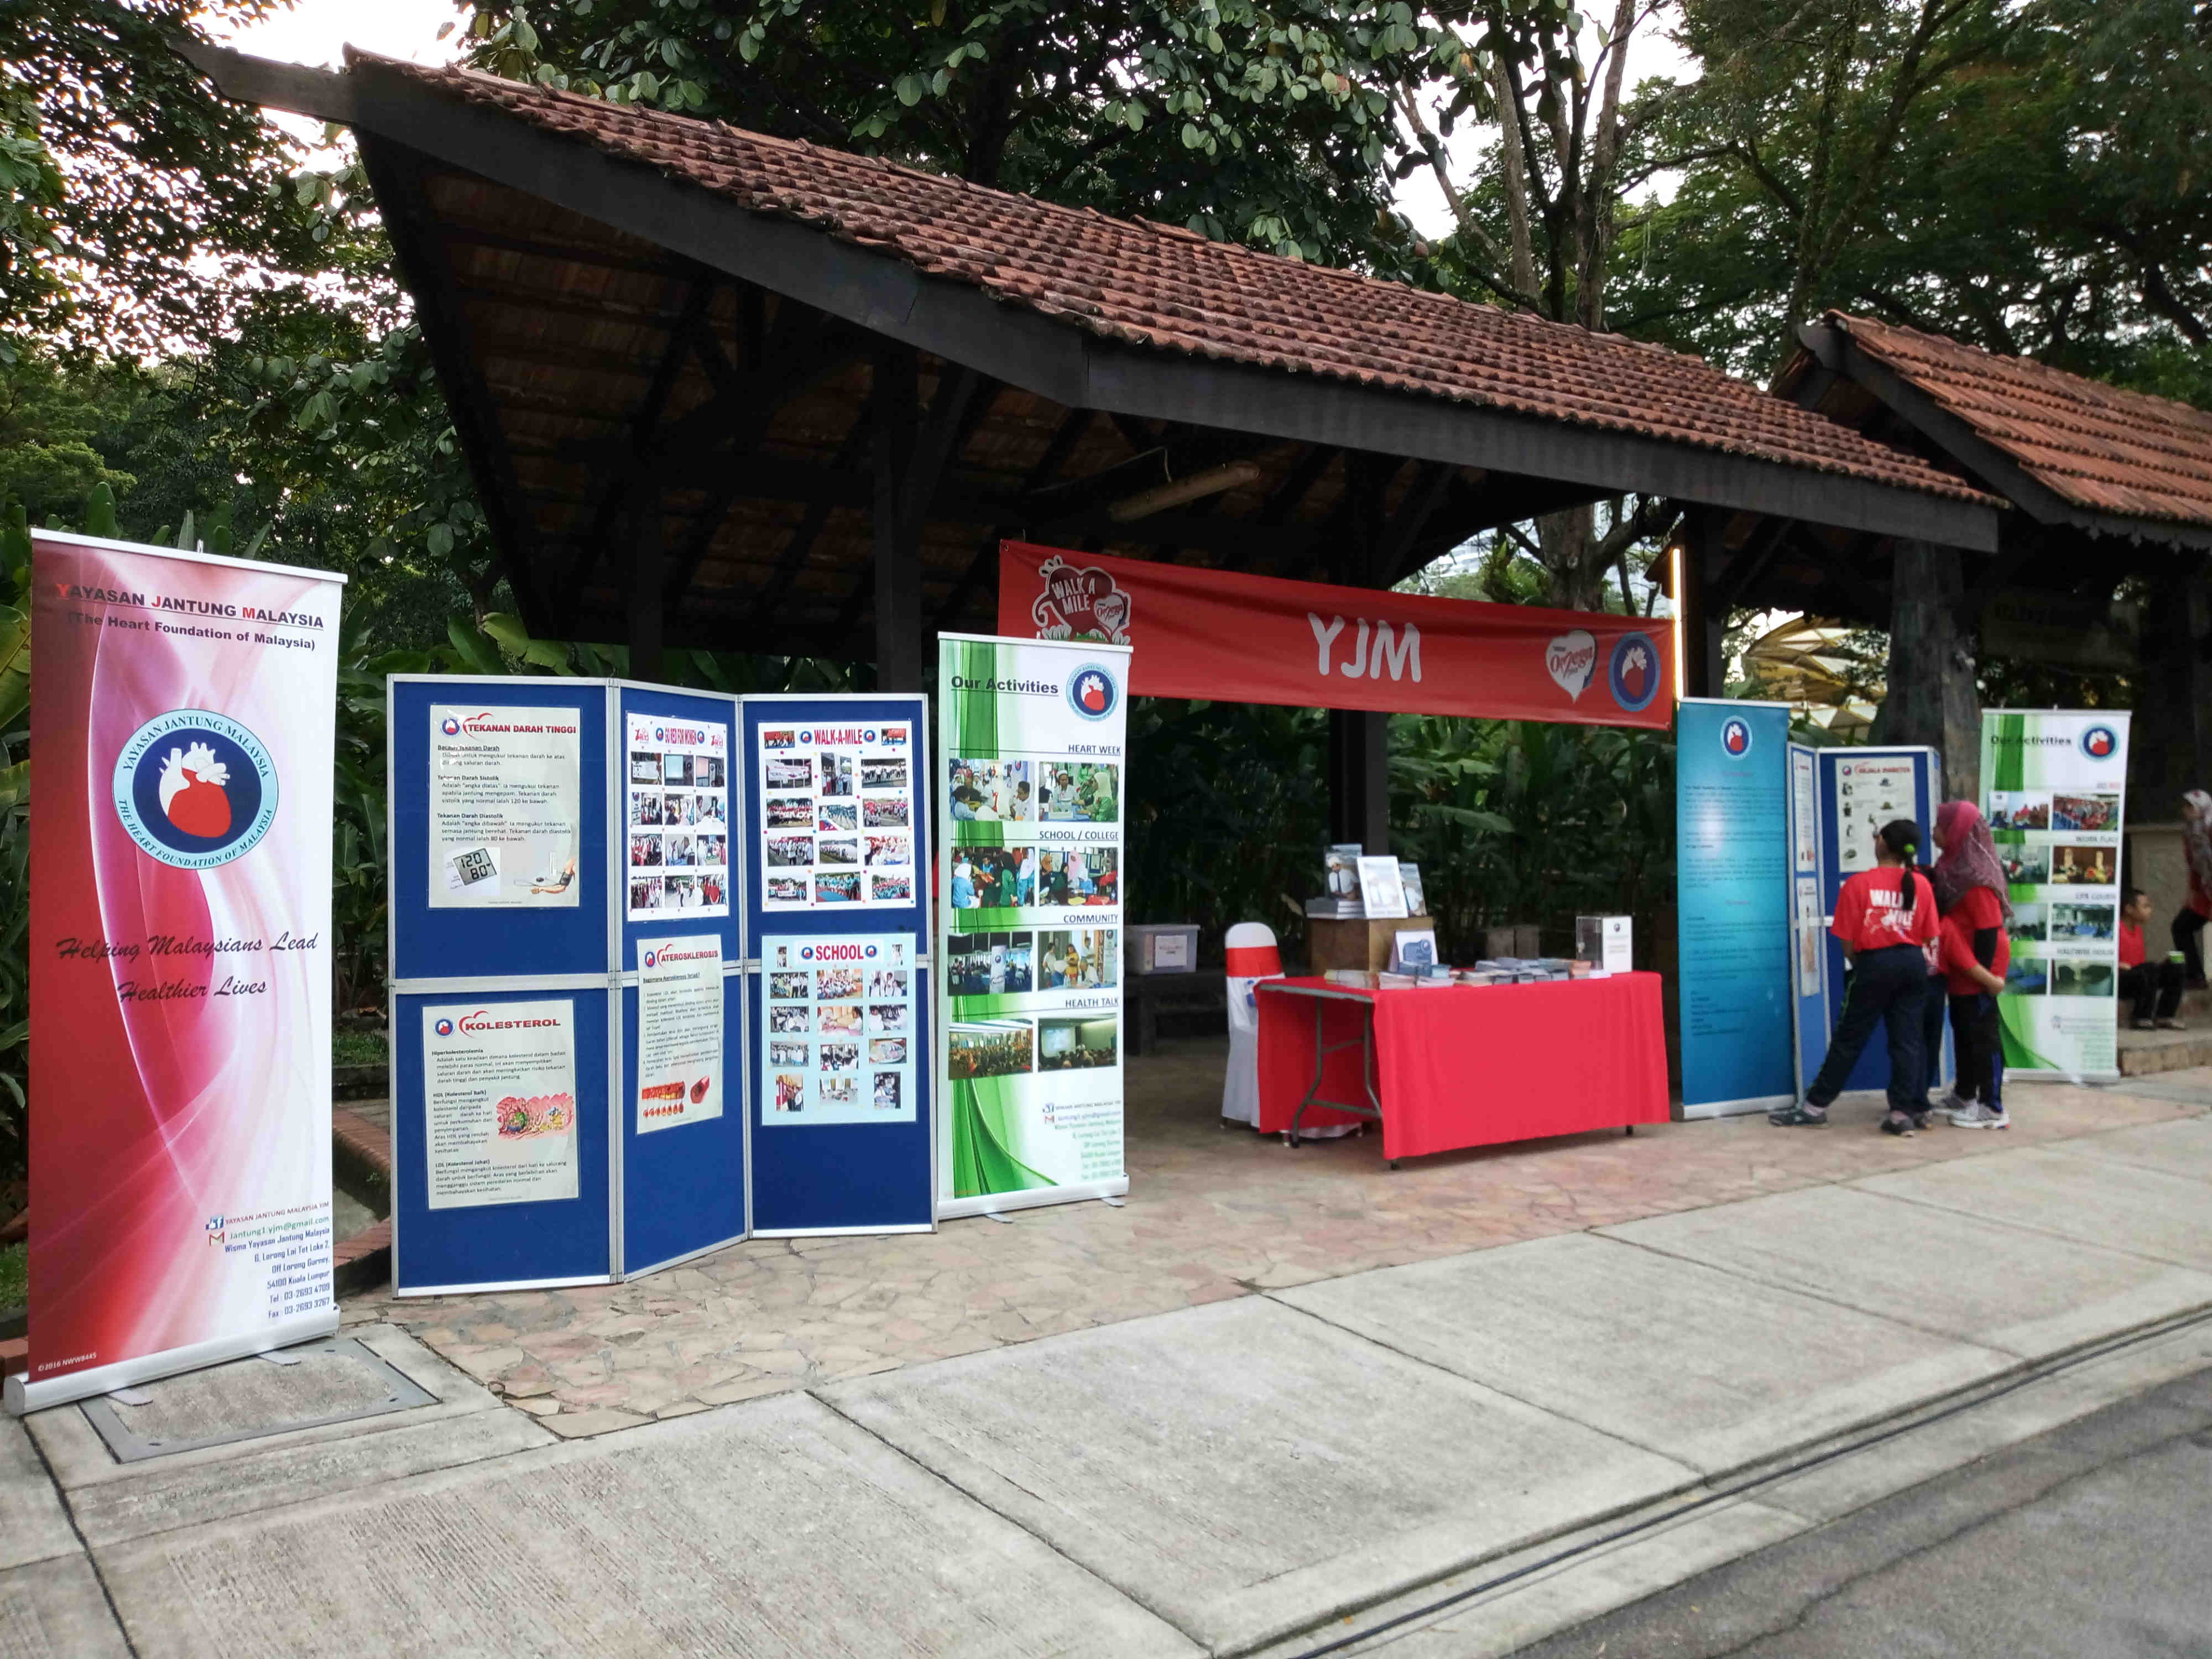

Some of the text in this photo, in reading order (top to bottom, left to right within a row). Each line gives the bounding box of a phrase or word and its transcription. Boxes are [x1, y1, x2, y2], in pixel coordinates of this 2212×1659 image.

[1051, 577, 1095, 600] WALK A
[57, 583, 324, 629] YAYASAN JANTUNG MALAYSIA
[1062, 594, 1091, 615] MILE
[108, 617, 151, 632] Heart
[154, 622, 232, 641] Foundation
[236, 631, 250, 642] of
[254, 633, 315, 651] Malaysia)
[1307, 612, 1422, 684] YJM
[951, 676, 1059, 694] Our Activities
[123, 716, 270, 778] YAYASAN JANTUNG MALAYSIA
[1068, 744, 1121, 755] HEART WEEK
[118, 799, 273, 868] THE HEART FOUNDATION OF MALAYSIA
[1039, 831, 1119, 841] SCHOOL / COLLEGE
[460, 852, 482, 868] 120
[470, 864, 488, 880] 80
[1063, 914, 1119, 924] COMMUNITY
[56, 931, 319, 963] Helping Malaysians Lead
[661, 950, 718, 962] ATEROSKLEROSIS
[816, 945, 864, 961] SCHOOL
[117, 975, 268, 1002] Healthier Lives
[1065, 998, 1119, 1008] HEALTH TALK
[466, 1019, 561, 1031] KOLESTEROL
[225, 1215, 254, 1225] YAYASAN
[255, 1211, 285, 1220] JANTUNG
[287, 1204, 318, 1214] MALAYSIA
[225, 1228, 330, 1253] Wisma Yayasan Jantung Malaysia
[288, 1275, 306, 1285] Kuala
